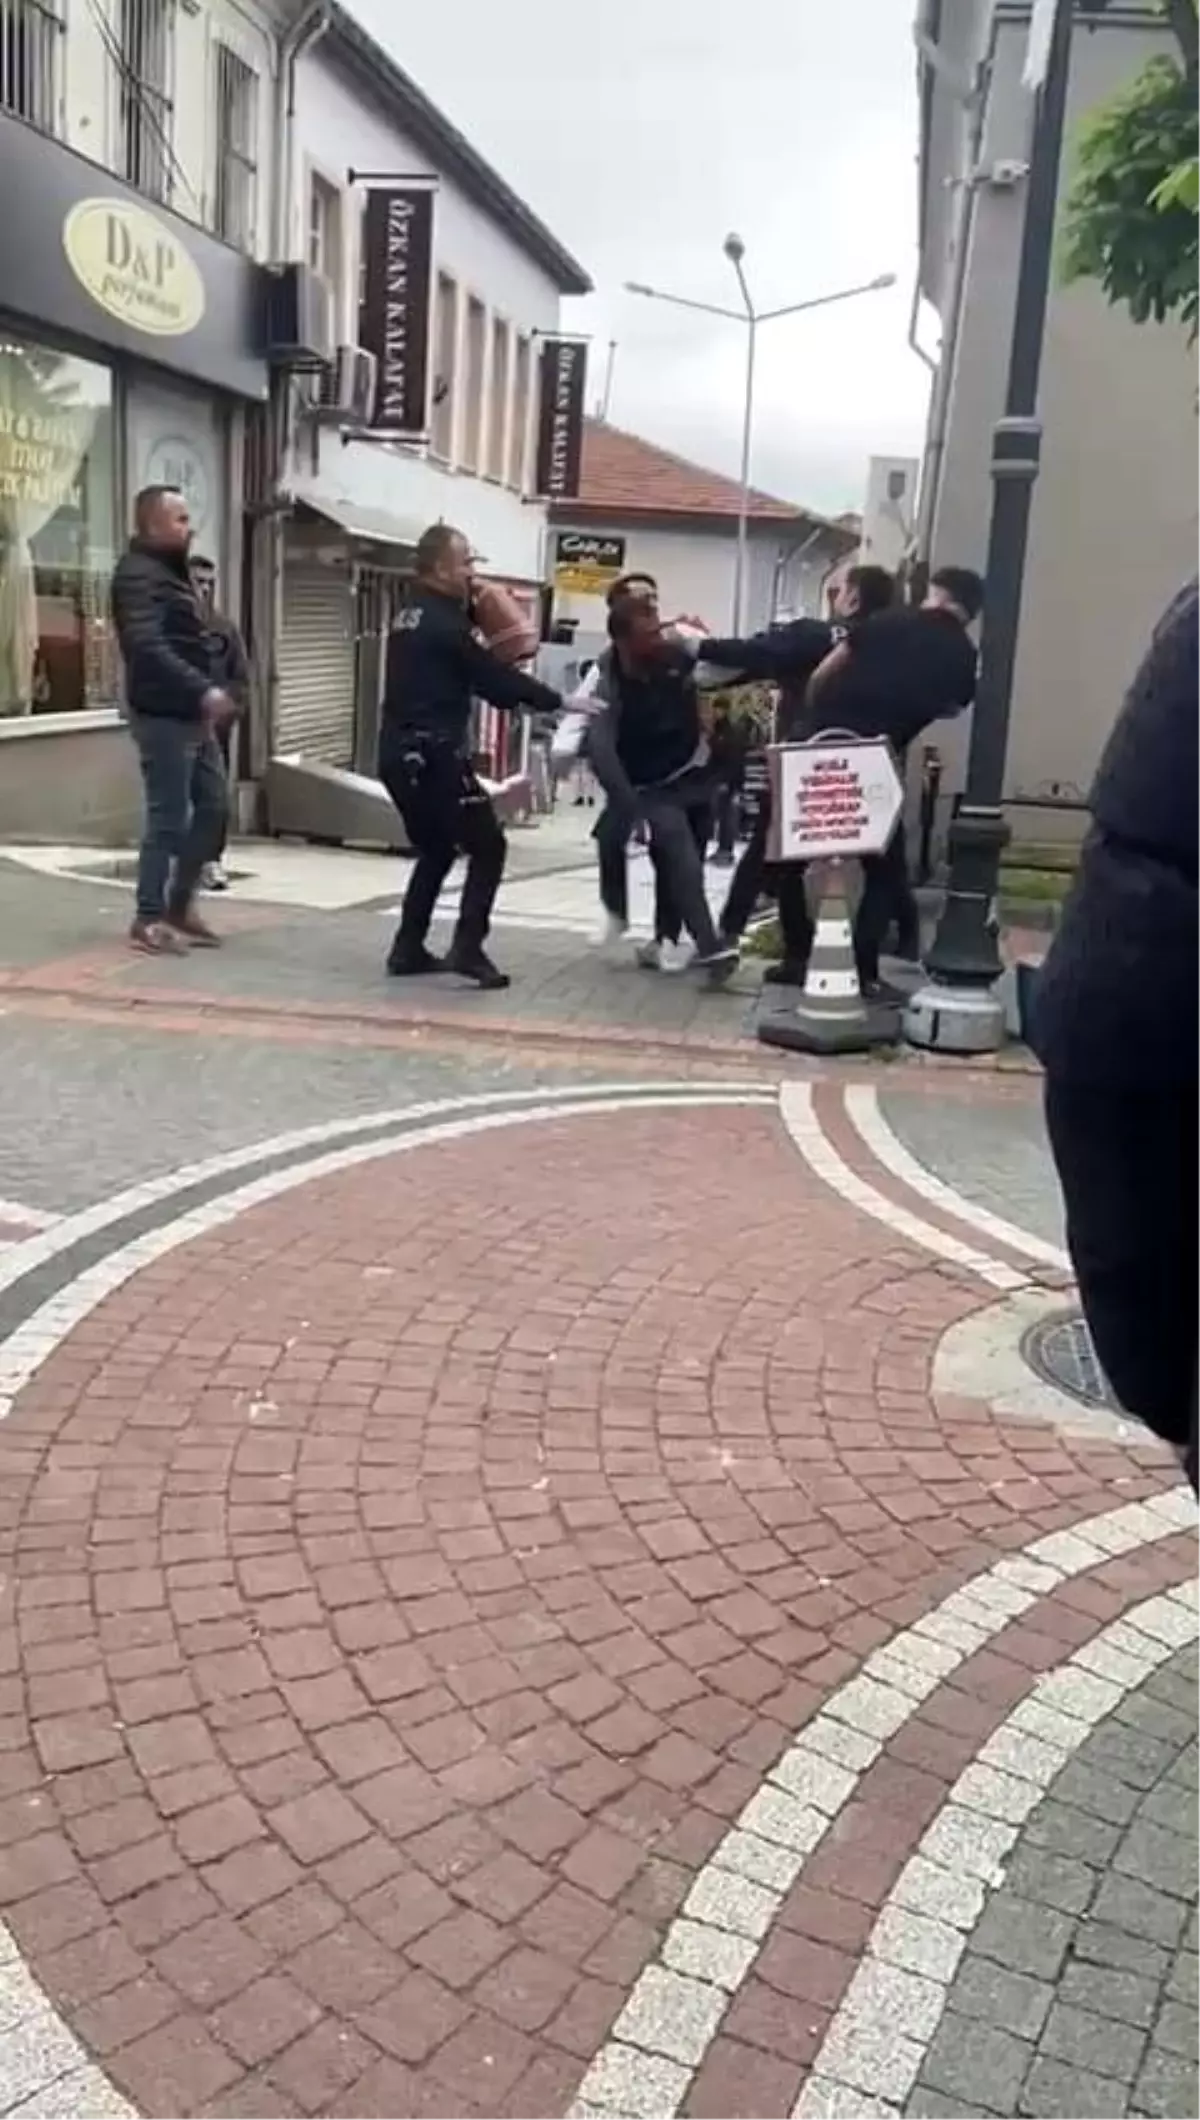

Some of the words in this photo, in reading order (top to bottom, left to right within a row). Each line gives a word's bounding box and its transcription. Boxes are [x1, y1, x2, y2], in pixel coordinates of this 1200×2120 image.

[106, 212, 175, 288] D&P
[386, 198, 415, 293] ÖZKAN
[384, 302, 407, 418] KALAFAT
